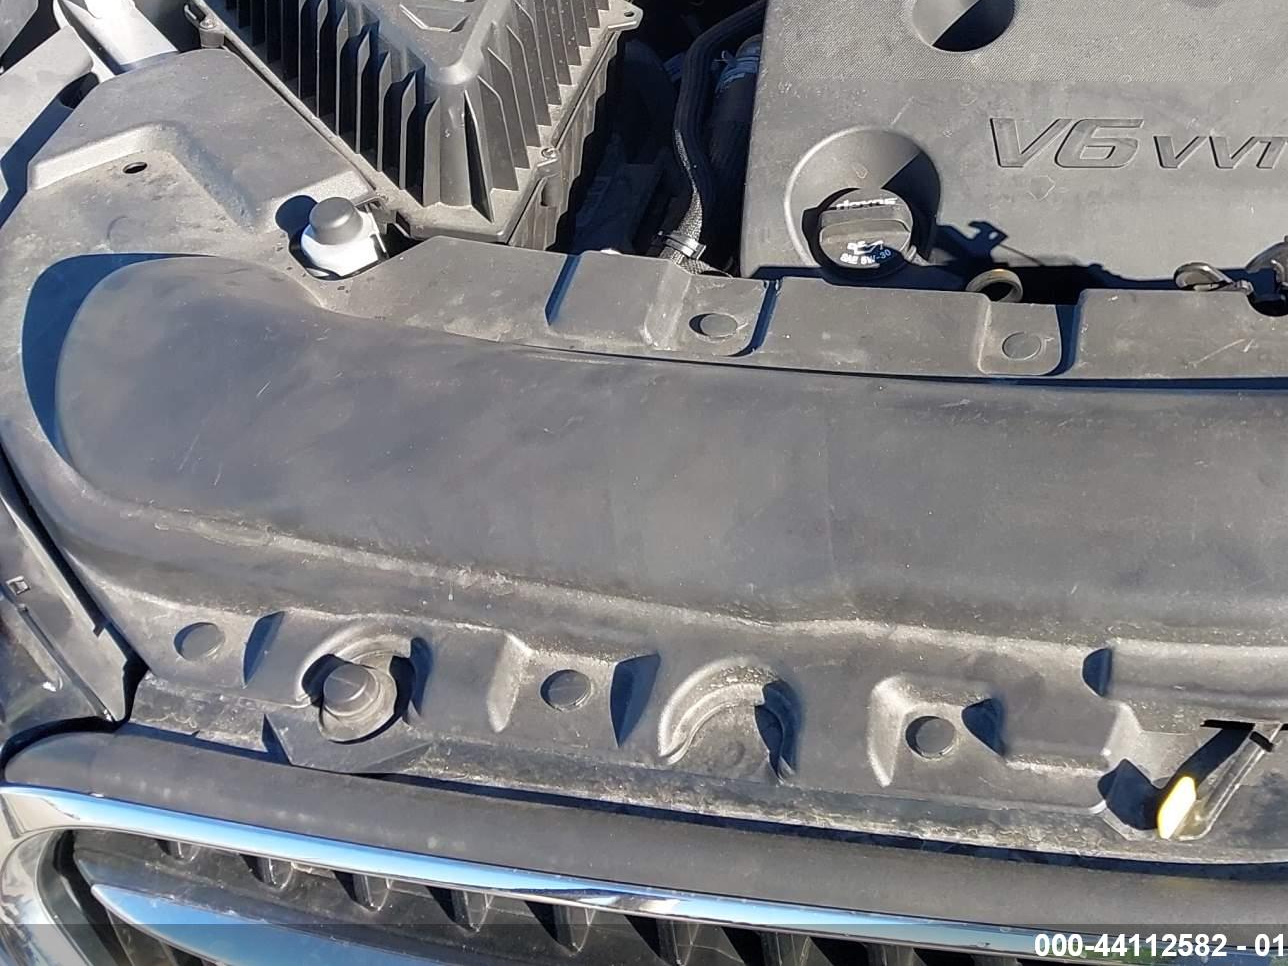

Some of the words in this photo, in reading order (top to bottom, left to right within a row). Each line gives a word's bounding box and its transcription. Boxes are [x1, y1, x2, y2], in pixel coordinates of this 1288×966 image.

[989, 118, 1144, 168] V6
[840, 253, 858, 265] SAE
[860, 249, 892, 265] 5W-30
